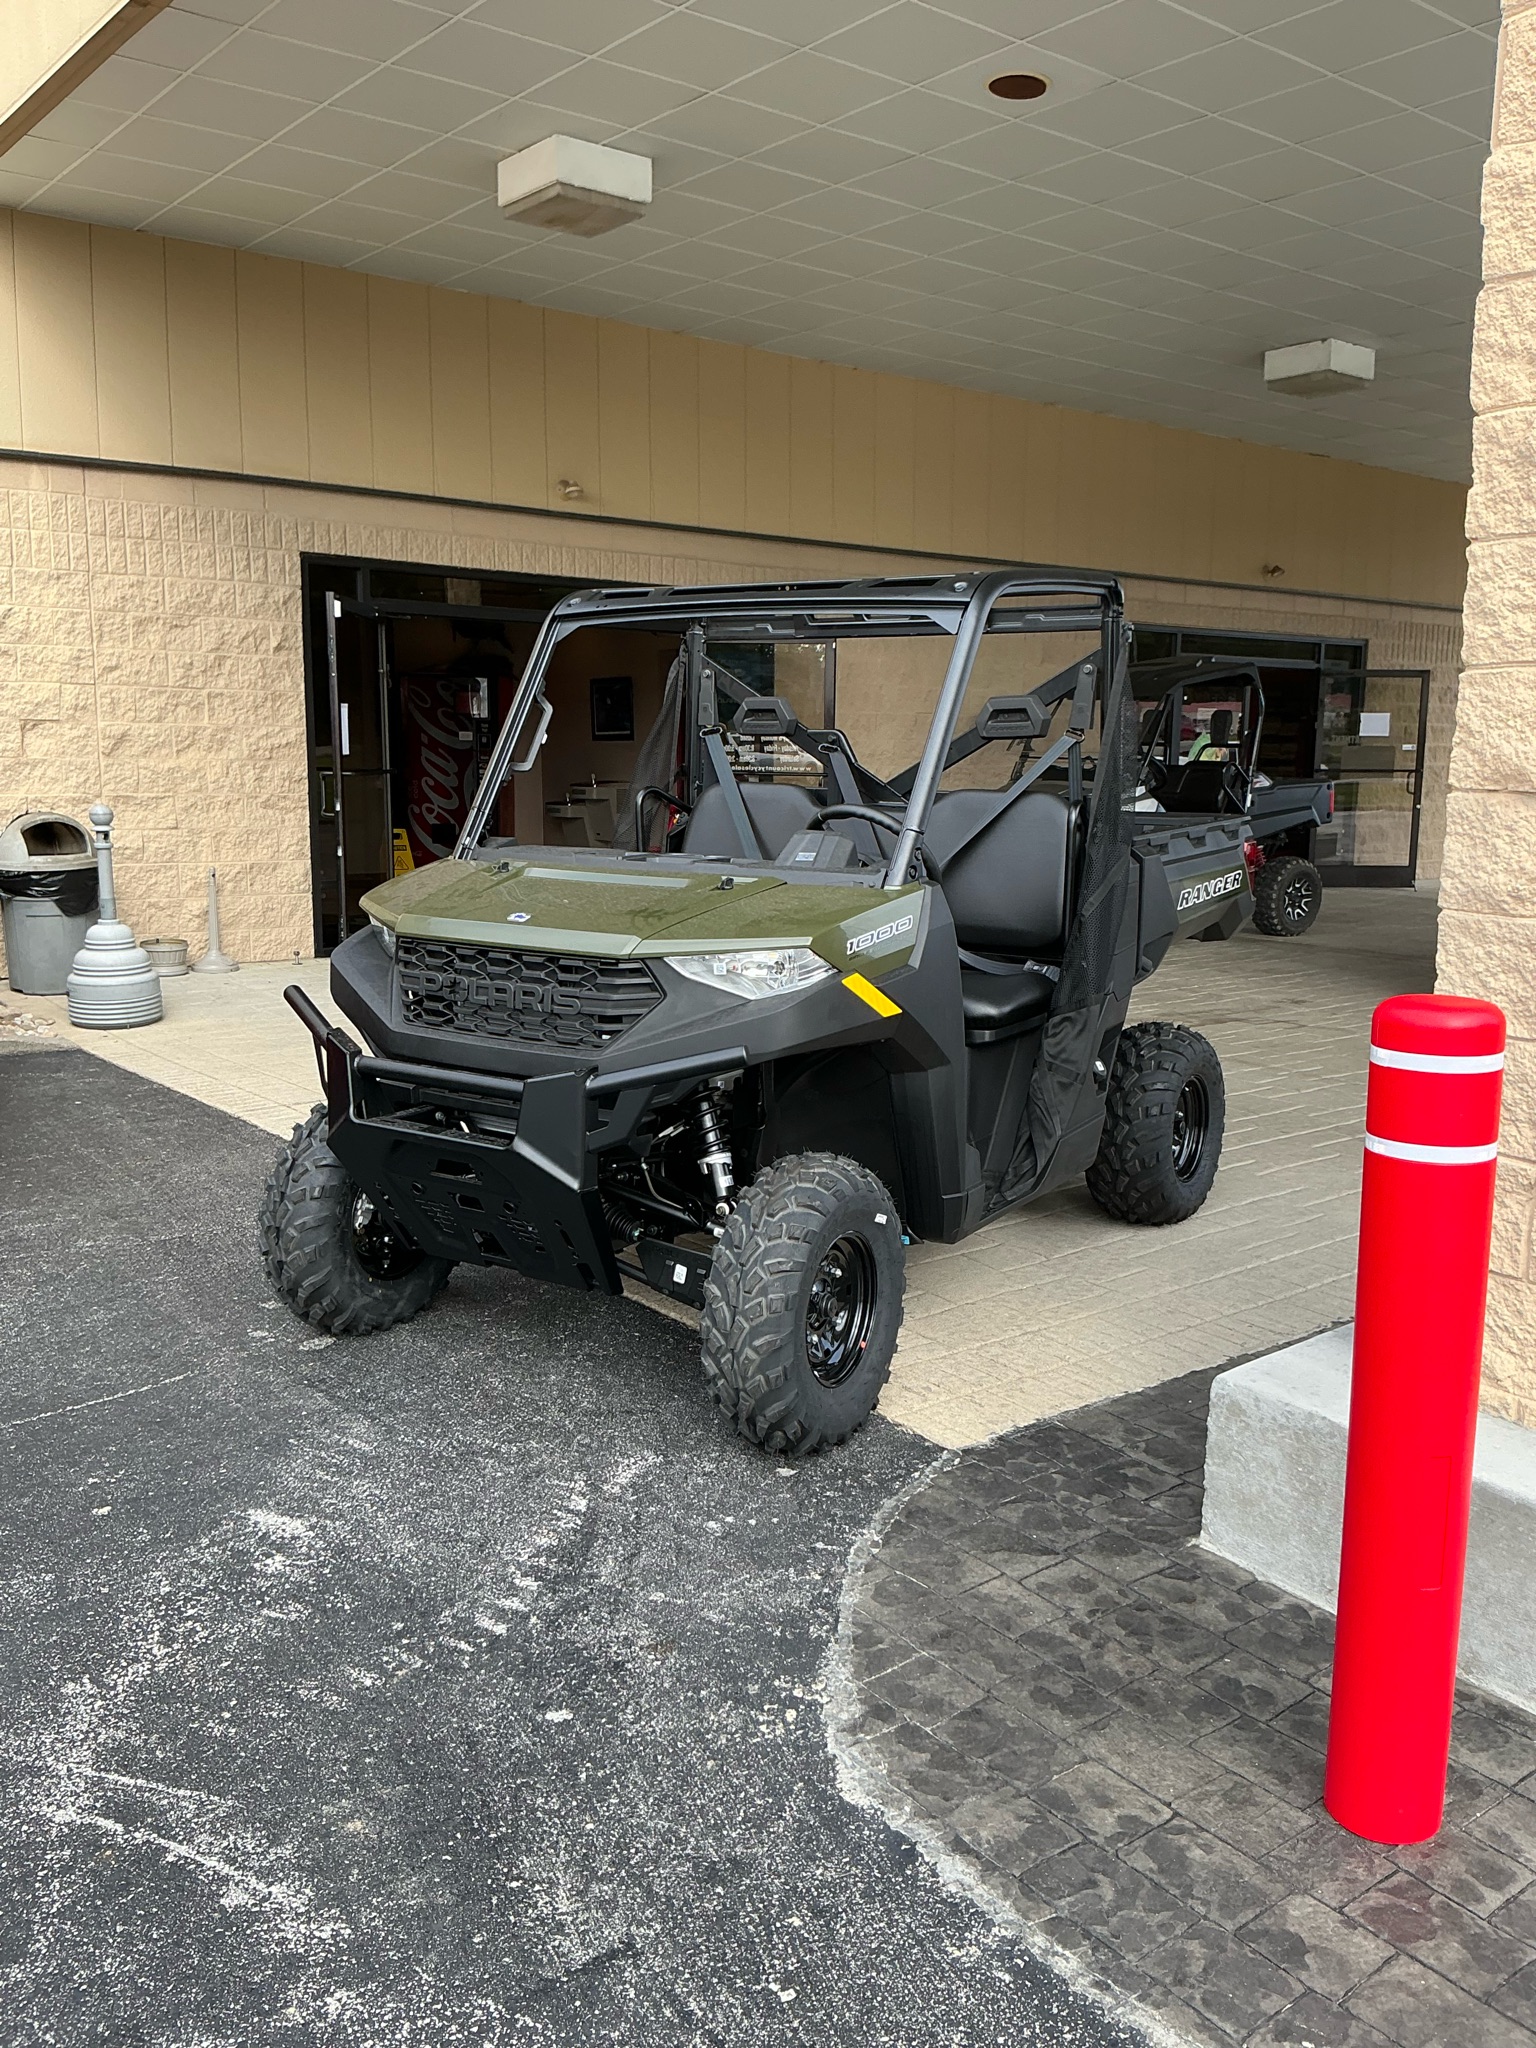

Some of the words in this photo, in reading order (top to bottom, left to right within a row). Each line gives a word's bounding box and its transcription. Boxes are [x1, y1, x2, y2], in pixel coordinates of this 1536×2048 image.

[407, 678, 475, 858] Coca-Cola
[1177, 870, 1243, 910] RANGER
[846, 915, 913, 955] 1000
[419, 972, 581, 1015] POLARIS
